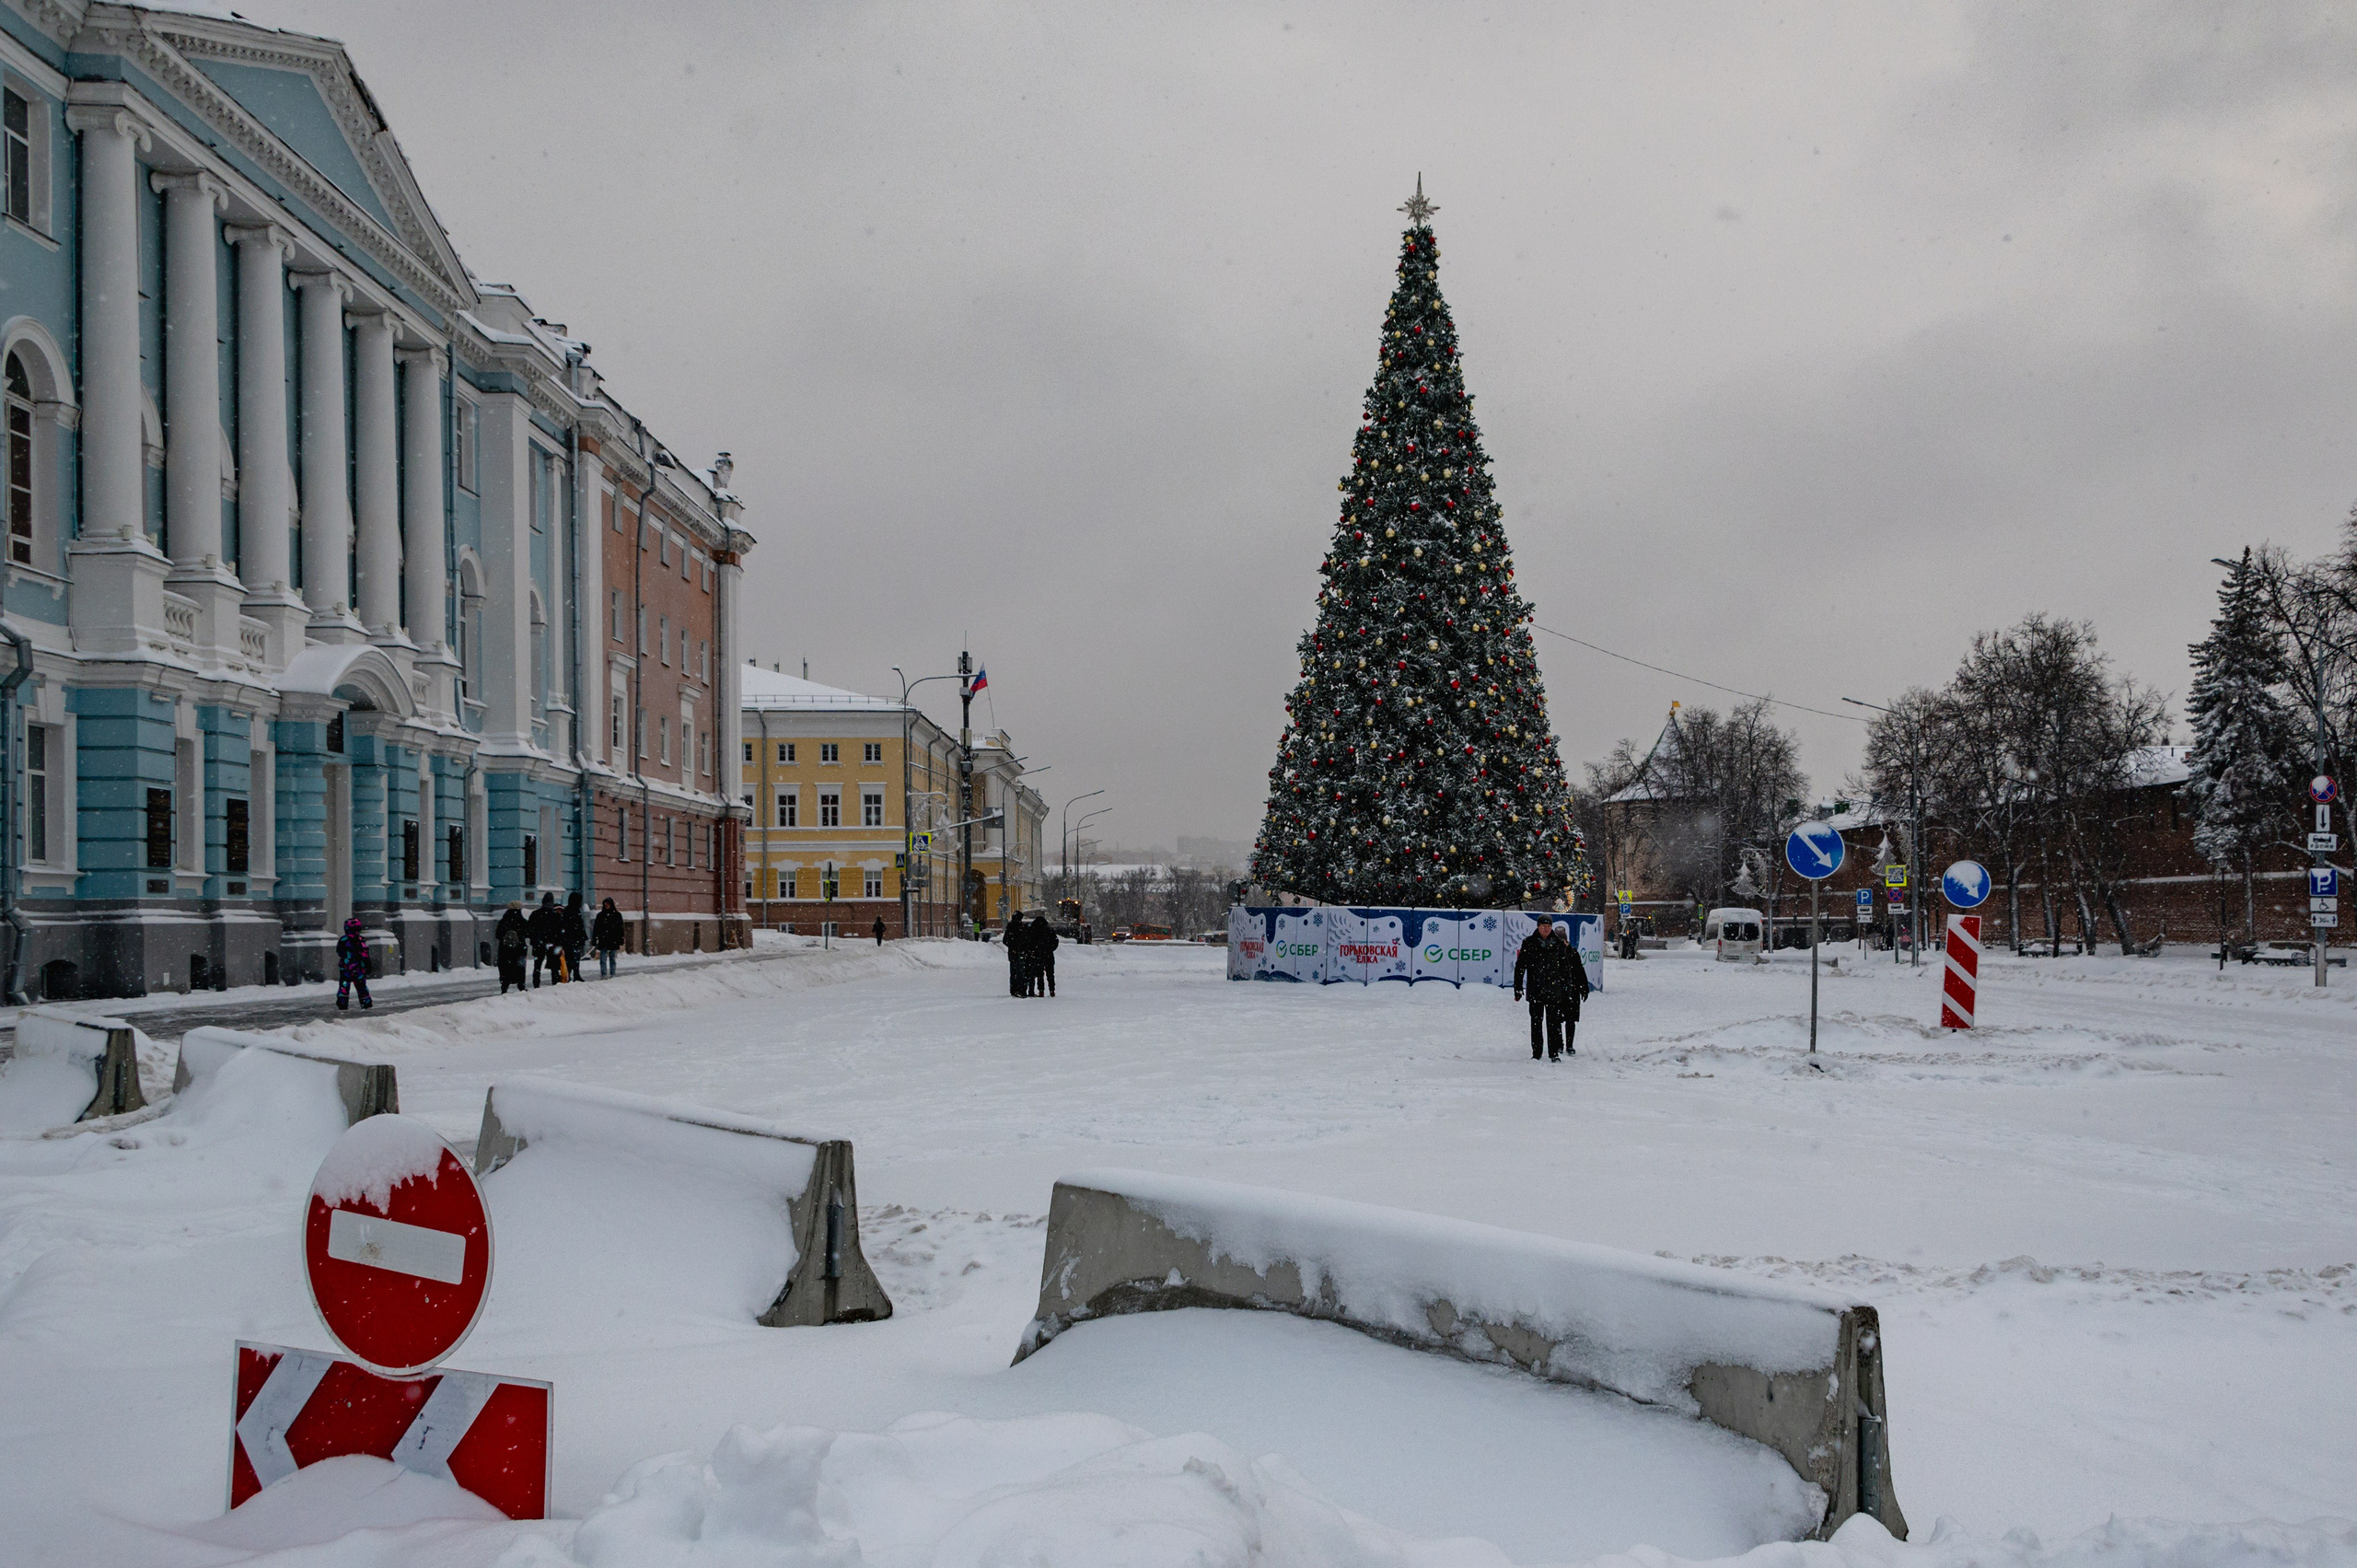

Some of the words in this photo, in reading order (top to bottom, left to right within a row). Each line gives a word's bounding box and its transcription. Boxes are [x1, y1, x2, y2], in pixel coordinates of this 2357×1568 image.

[2317, 872, 2331, 893] P
[1861, 890, 1870, 903] P
[1289, 944, 1319, 956] СБЕР
[1340, 945, 1398, 958] ГОРЬКОВСКАЯ
[1447, 948, 1492, 961] СБЕР
